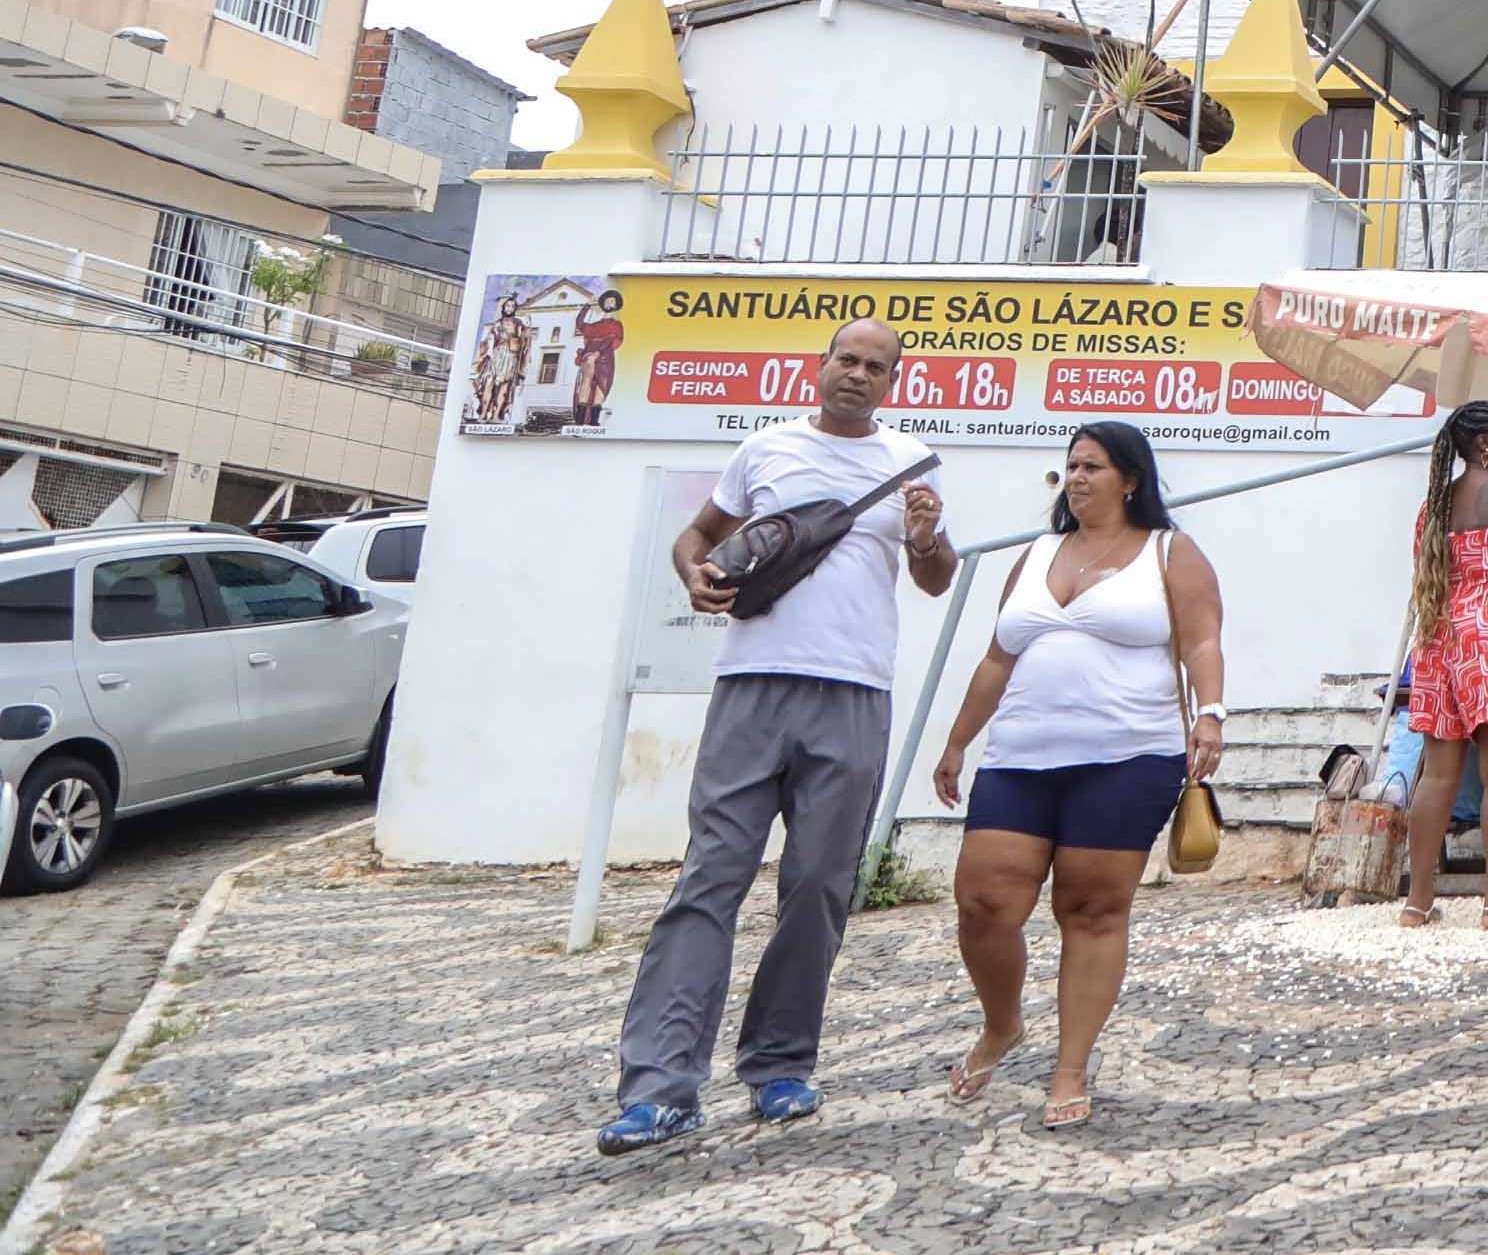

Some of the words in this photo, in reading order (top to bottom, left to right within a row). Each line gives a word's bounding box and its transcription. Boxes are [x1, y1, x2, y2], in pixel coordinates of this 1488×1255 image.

[666, 288, 876, 321] SANTUÁRIO
[887, 295, 935, 322] DE
[945, 291, 1021, 324] SÃO
[1032, 292, 1178, 327] LÁZARO
[1189, 301, 1211, 327] E
[1275, 291, 1345, 329] PURO
[1353, 301, 1441, 340] MALTE
[898, 327, 1022, 352] ORÁRIOS
[1032, 333, 1067, 352] DE
[1076, 333, 1185, 355] MISSAS:
[655, 360, 749, 377] SEGUNDA
[760, 358, 815, 402] 07h
[955, 362, 1008, 406] 18h
[1056, 368, 1080, 383] DE
[1086, 368, 1145, 388] TERÇA
[671, 381, 727, 397] FEIRA
[1052, 389, 1065, 404] A
[1069, 386, 1145, 405] SÁBADO
[1232, 379, 1322, 401] DOMINGO
[716, 415, 748, 430] TEL
[900, 417, 960, 435] EMAIL:
